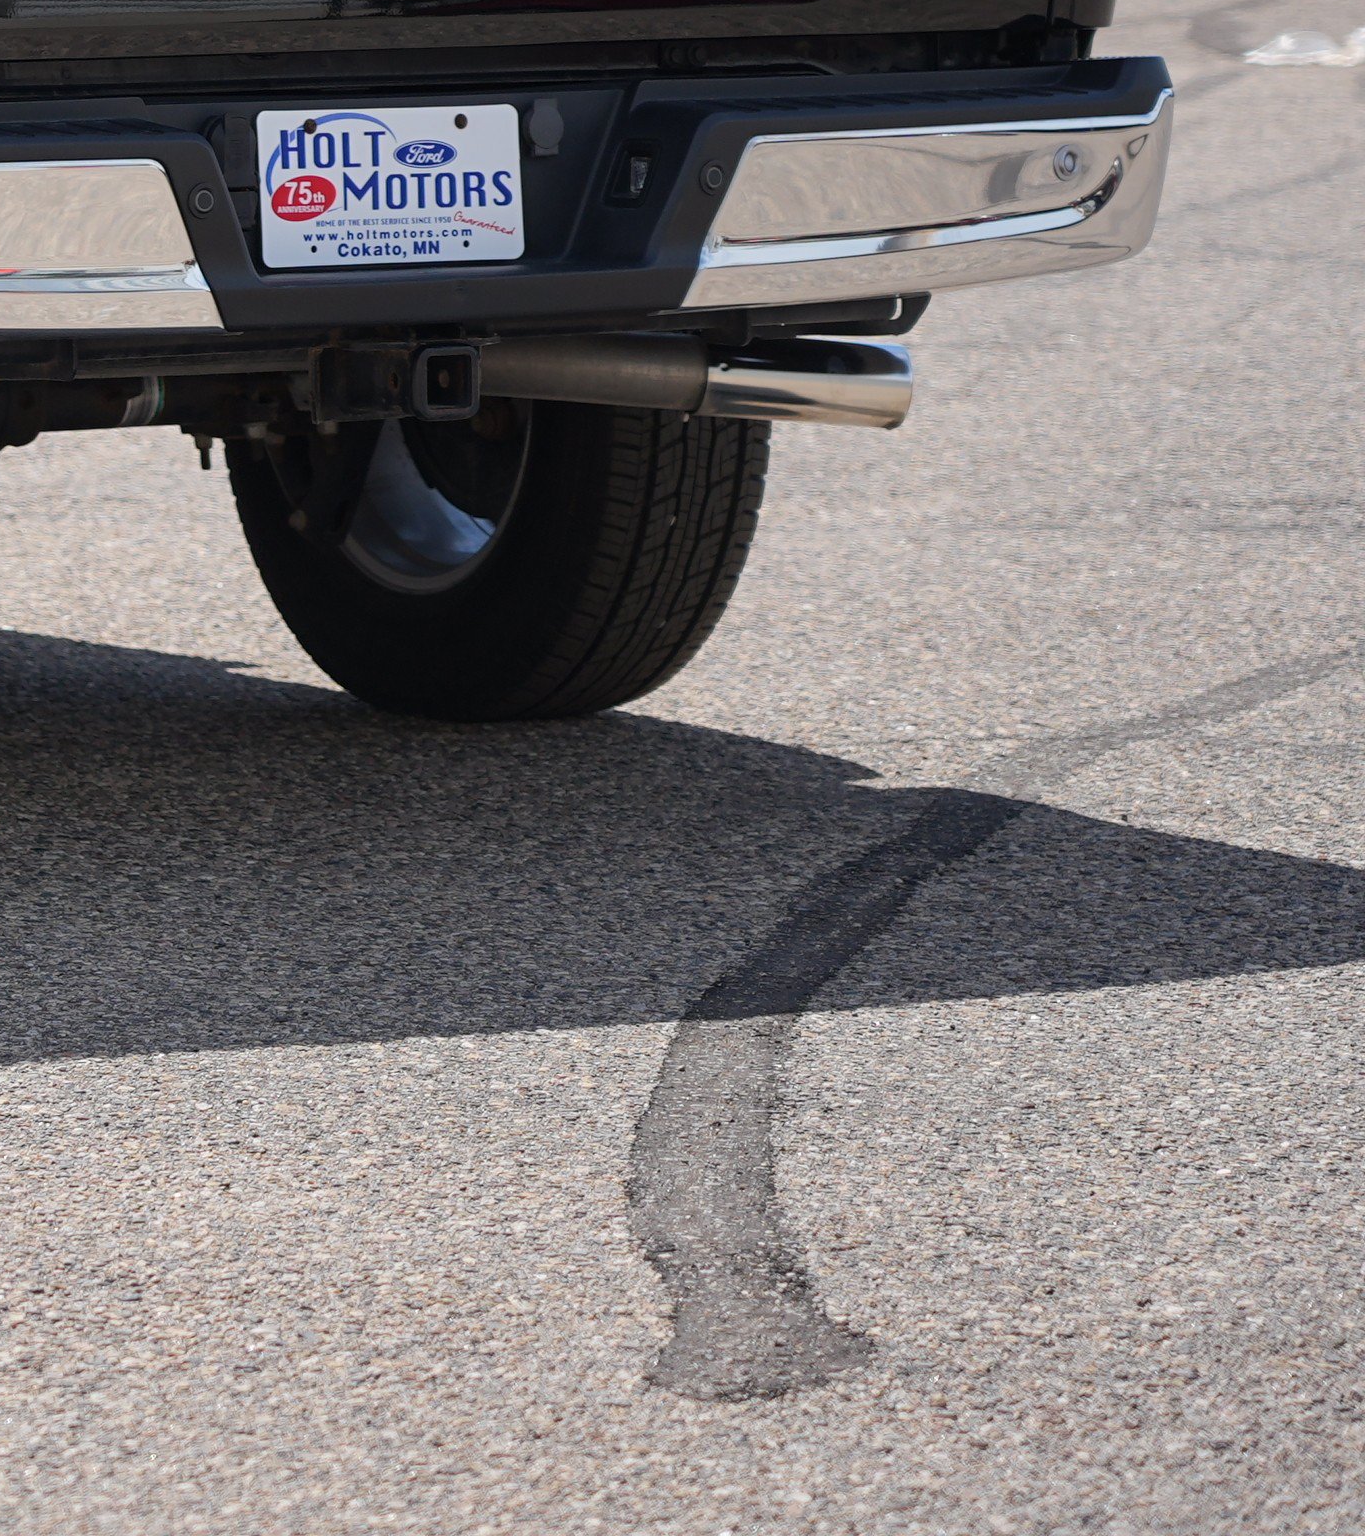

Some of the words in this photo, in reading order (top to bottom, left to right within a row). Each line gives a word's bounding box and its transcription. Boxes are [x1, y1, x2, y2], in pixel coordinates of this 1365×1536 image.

[280, 129, 386, 169] HOLT
[406, 144, 444, 163] Ford
[284, 181, 326, 205] 75th
[343, 170, 512, 211] MOTORS
[277, 205, 325, 214] ANNIVERSARY
[316, 219, 336, 227] HOME
[338, 218, 346, 226] OF
[348, 218, 360, 226] THE
[434, 216, 451, 224] 1950
[454, 211, 516, 236] Guaranteed
[303, 227, 473, 242] www.holtmotors.com
[338, 243, 407, 258] Cokato,
[413, 241, 440, 254] MN
